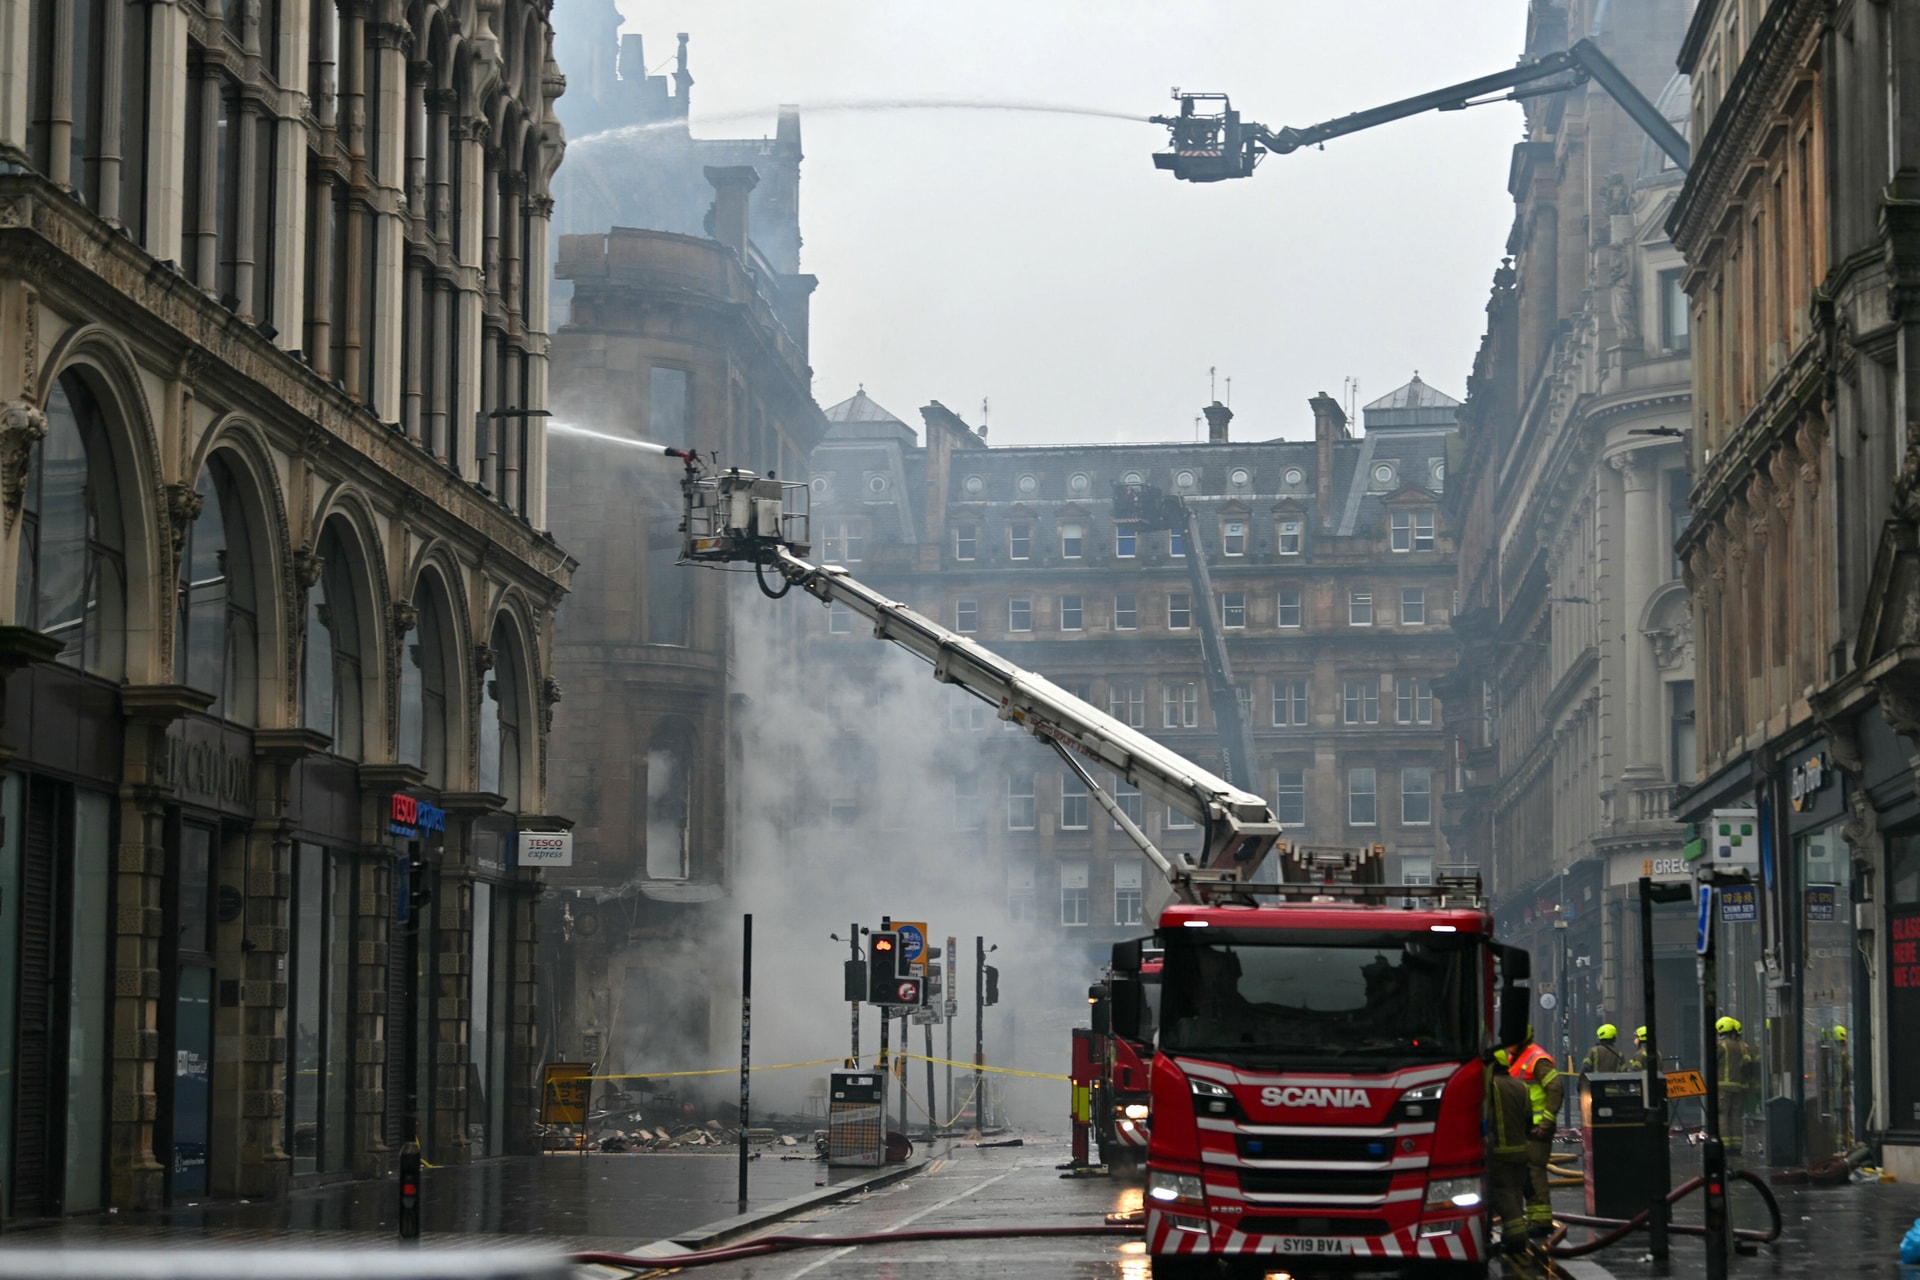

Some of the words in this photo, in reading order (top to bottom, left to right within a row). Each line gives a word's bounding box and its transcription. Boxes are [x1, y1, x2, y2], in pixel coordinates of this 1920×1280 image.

[392, 794, 417, 825] TESCO
[528, 839, 564, 848] TESCO
[527, 850, 563, 860] express
[1653, 859, 1689, 874] GREG
[1261, 1086, 1372, 1108] SCANIA
[1284, 1239, 1314, 1252] SY19
[1317, 1239, 1343, 1252] BVA
